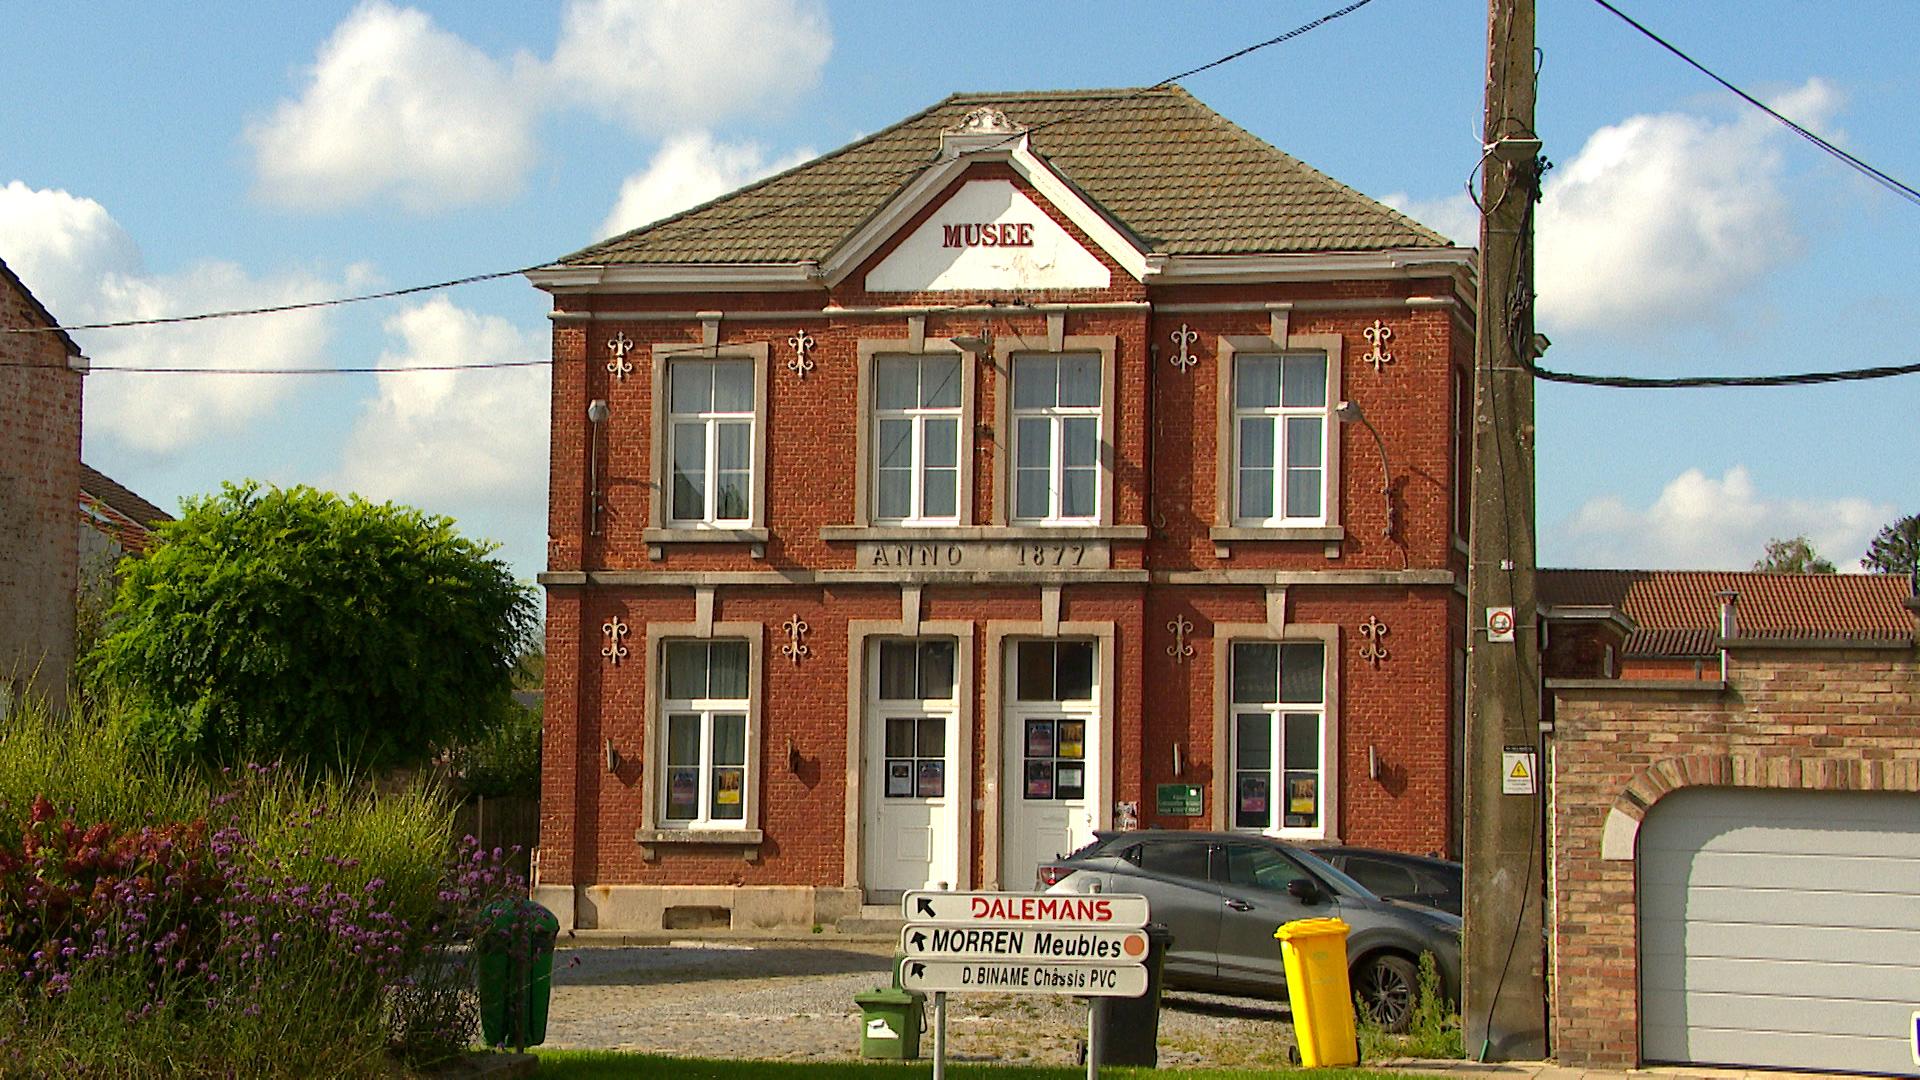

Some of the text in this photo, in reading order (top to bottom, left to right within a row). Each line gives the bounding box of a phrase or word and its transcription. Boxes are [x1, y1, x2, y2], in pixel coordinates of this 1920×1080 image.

[942, 223, 1035, 248] MUSEE
[872, 544, 1086, 567] ANNO 1877
[971, 897, 1113, 921] DALEMANS
[931, 929, 1121, 957] MORREN Meubles
[1034, 967, 1085, 987] Châssis
[1090, 969, 1117, 988] PVC
